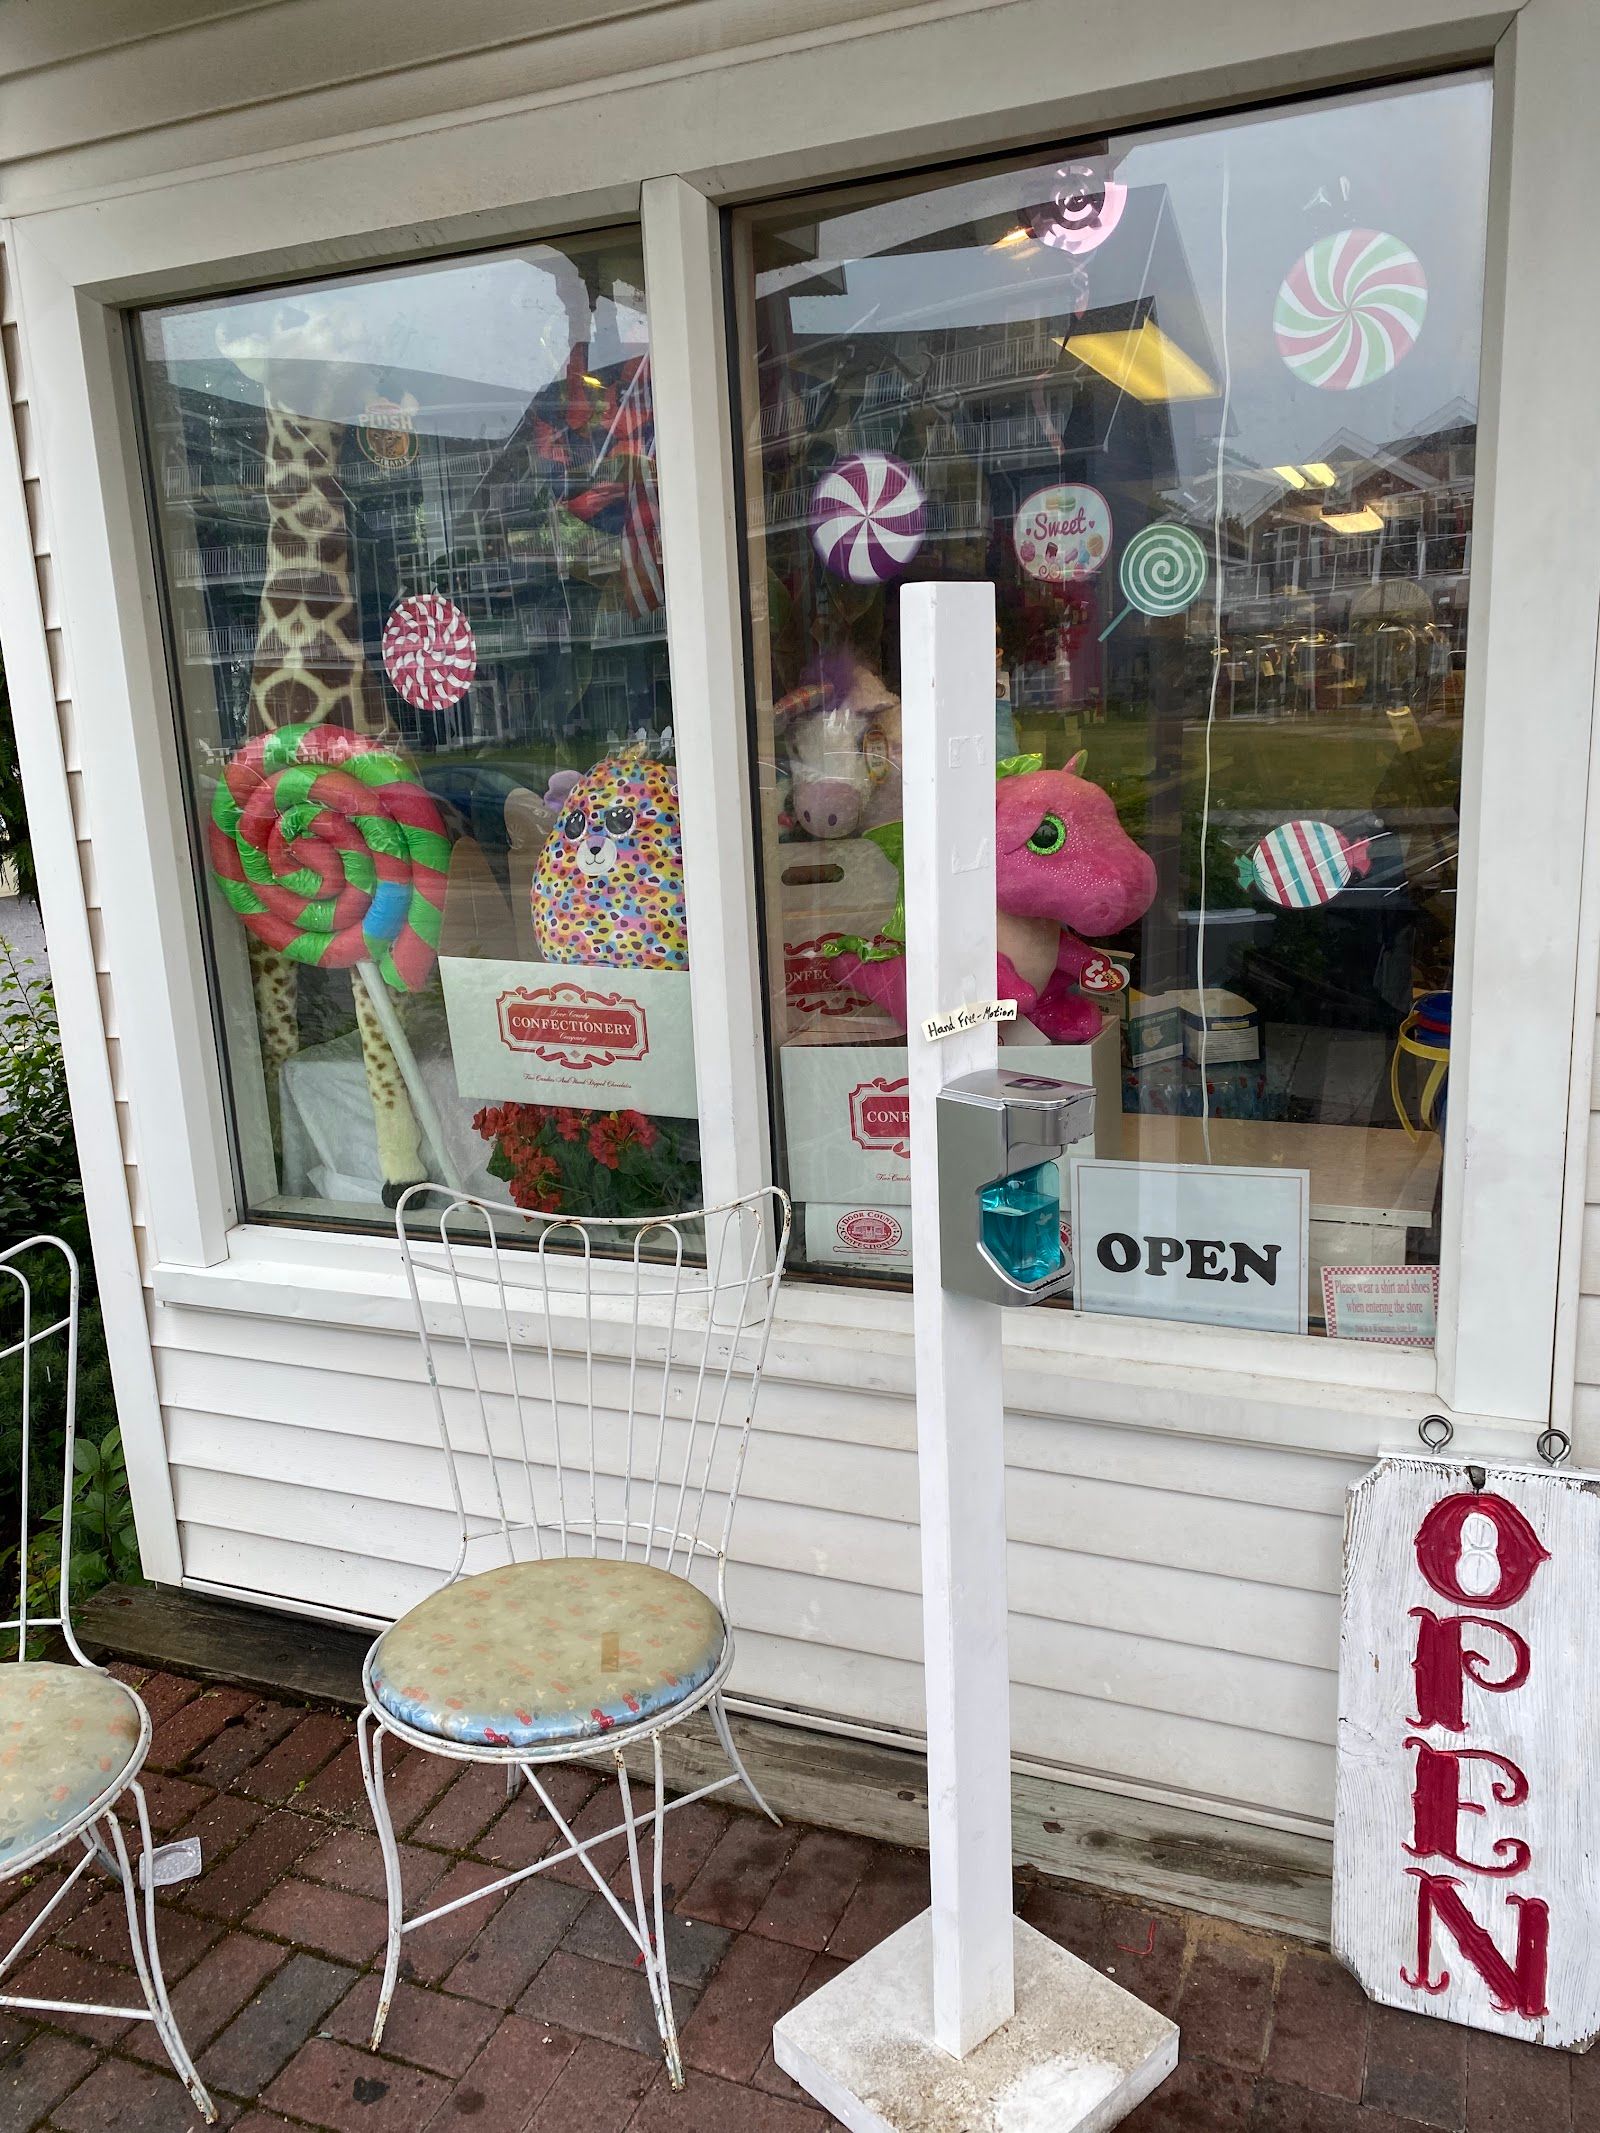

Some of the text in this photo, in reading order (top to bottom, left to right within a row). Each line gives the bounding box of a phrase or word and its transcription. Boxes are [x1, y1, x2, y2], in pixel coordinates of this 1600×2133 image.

[1033, 507, 1087, 540] Sweet
[512, 1016, 632, 1035] CONFECTIONERY
[928, 1015, 956, 1037] Hand
[559, 1032, 588, 1042] Company
[841, 1211, 897, 1229] DOOR COUNTY
[1097, 1232, 1281, 1286] OPEN
[1335, 1280, 1356, 1294] Please
[1357, 1283, 1373, 1294] wear
[1397, 1279, 1410, 1294] and
[1411, 1279, 1430, 1294] shoes
[1346, 1299, 1424, 1317] when entering the store
[1400, 1492, 1552, 2018] OPEN
